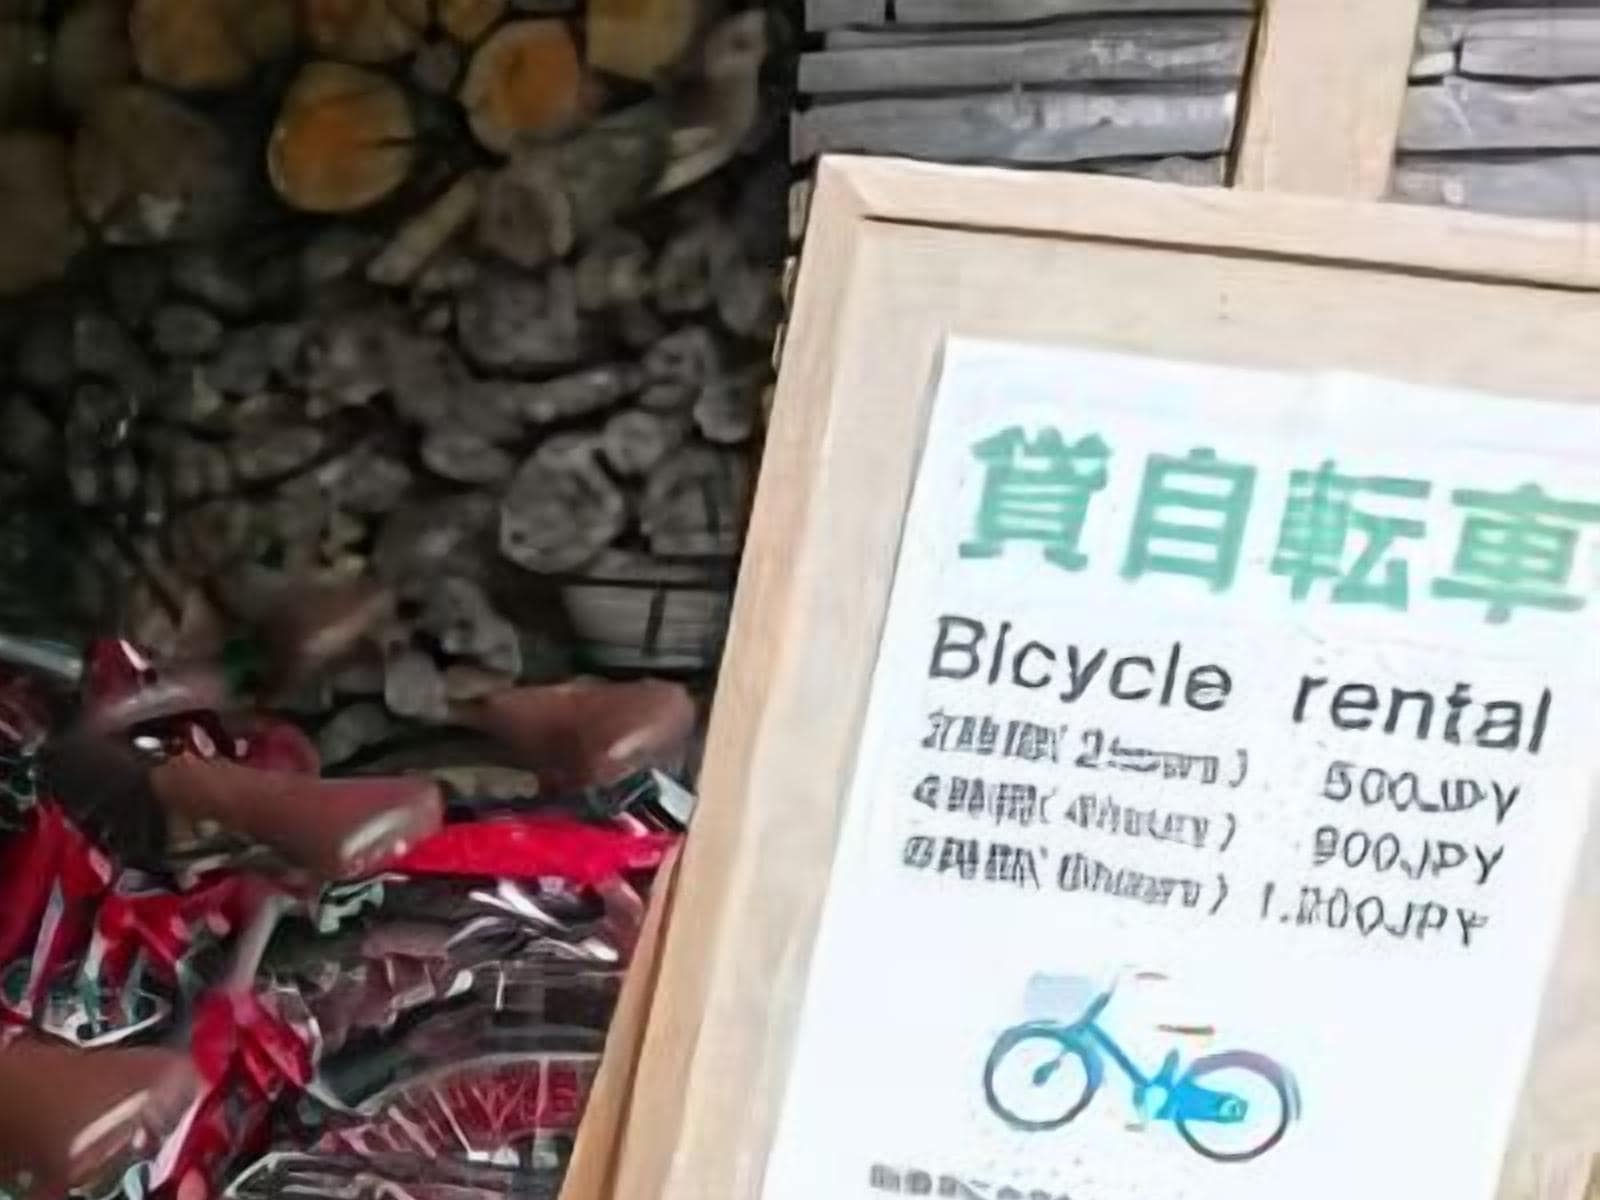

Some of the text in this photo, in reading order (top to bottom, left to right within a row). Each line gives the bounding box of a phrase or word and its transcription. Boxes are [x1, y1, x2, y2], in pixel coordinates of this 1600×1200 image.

[957, 425, 1600, 625] 貸自転車
[927, 613, 1234, 713] Bicycle
[1290, 673, 1554, 757] rental
